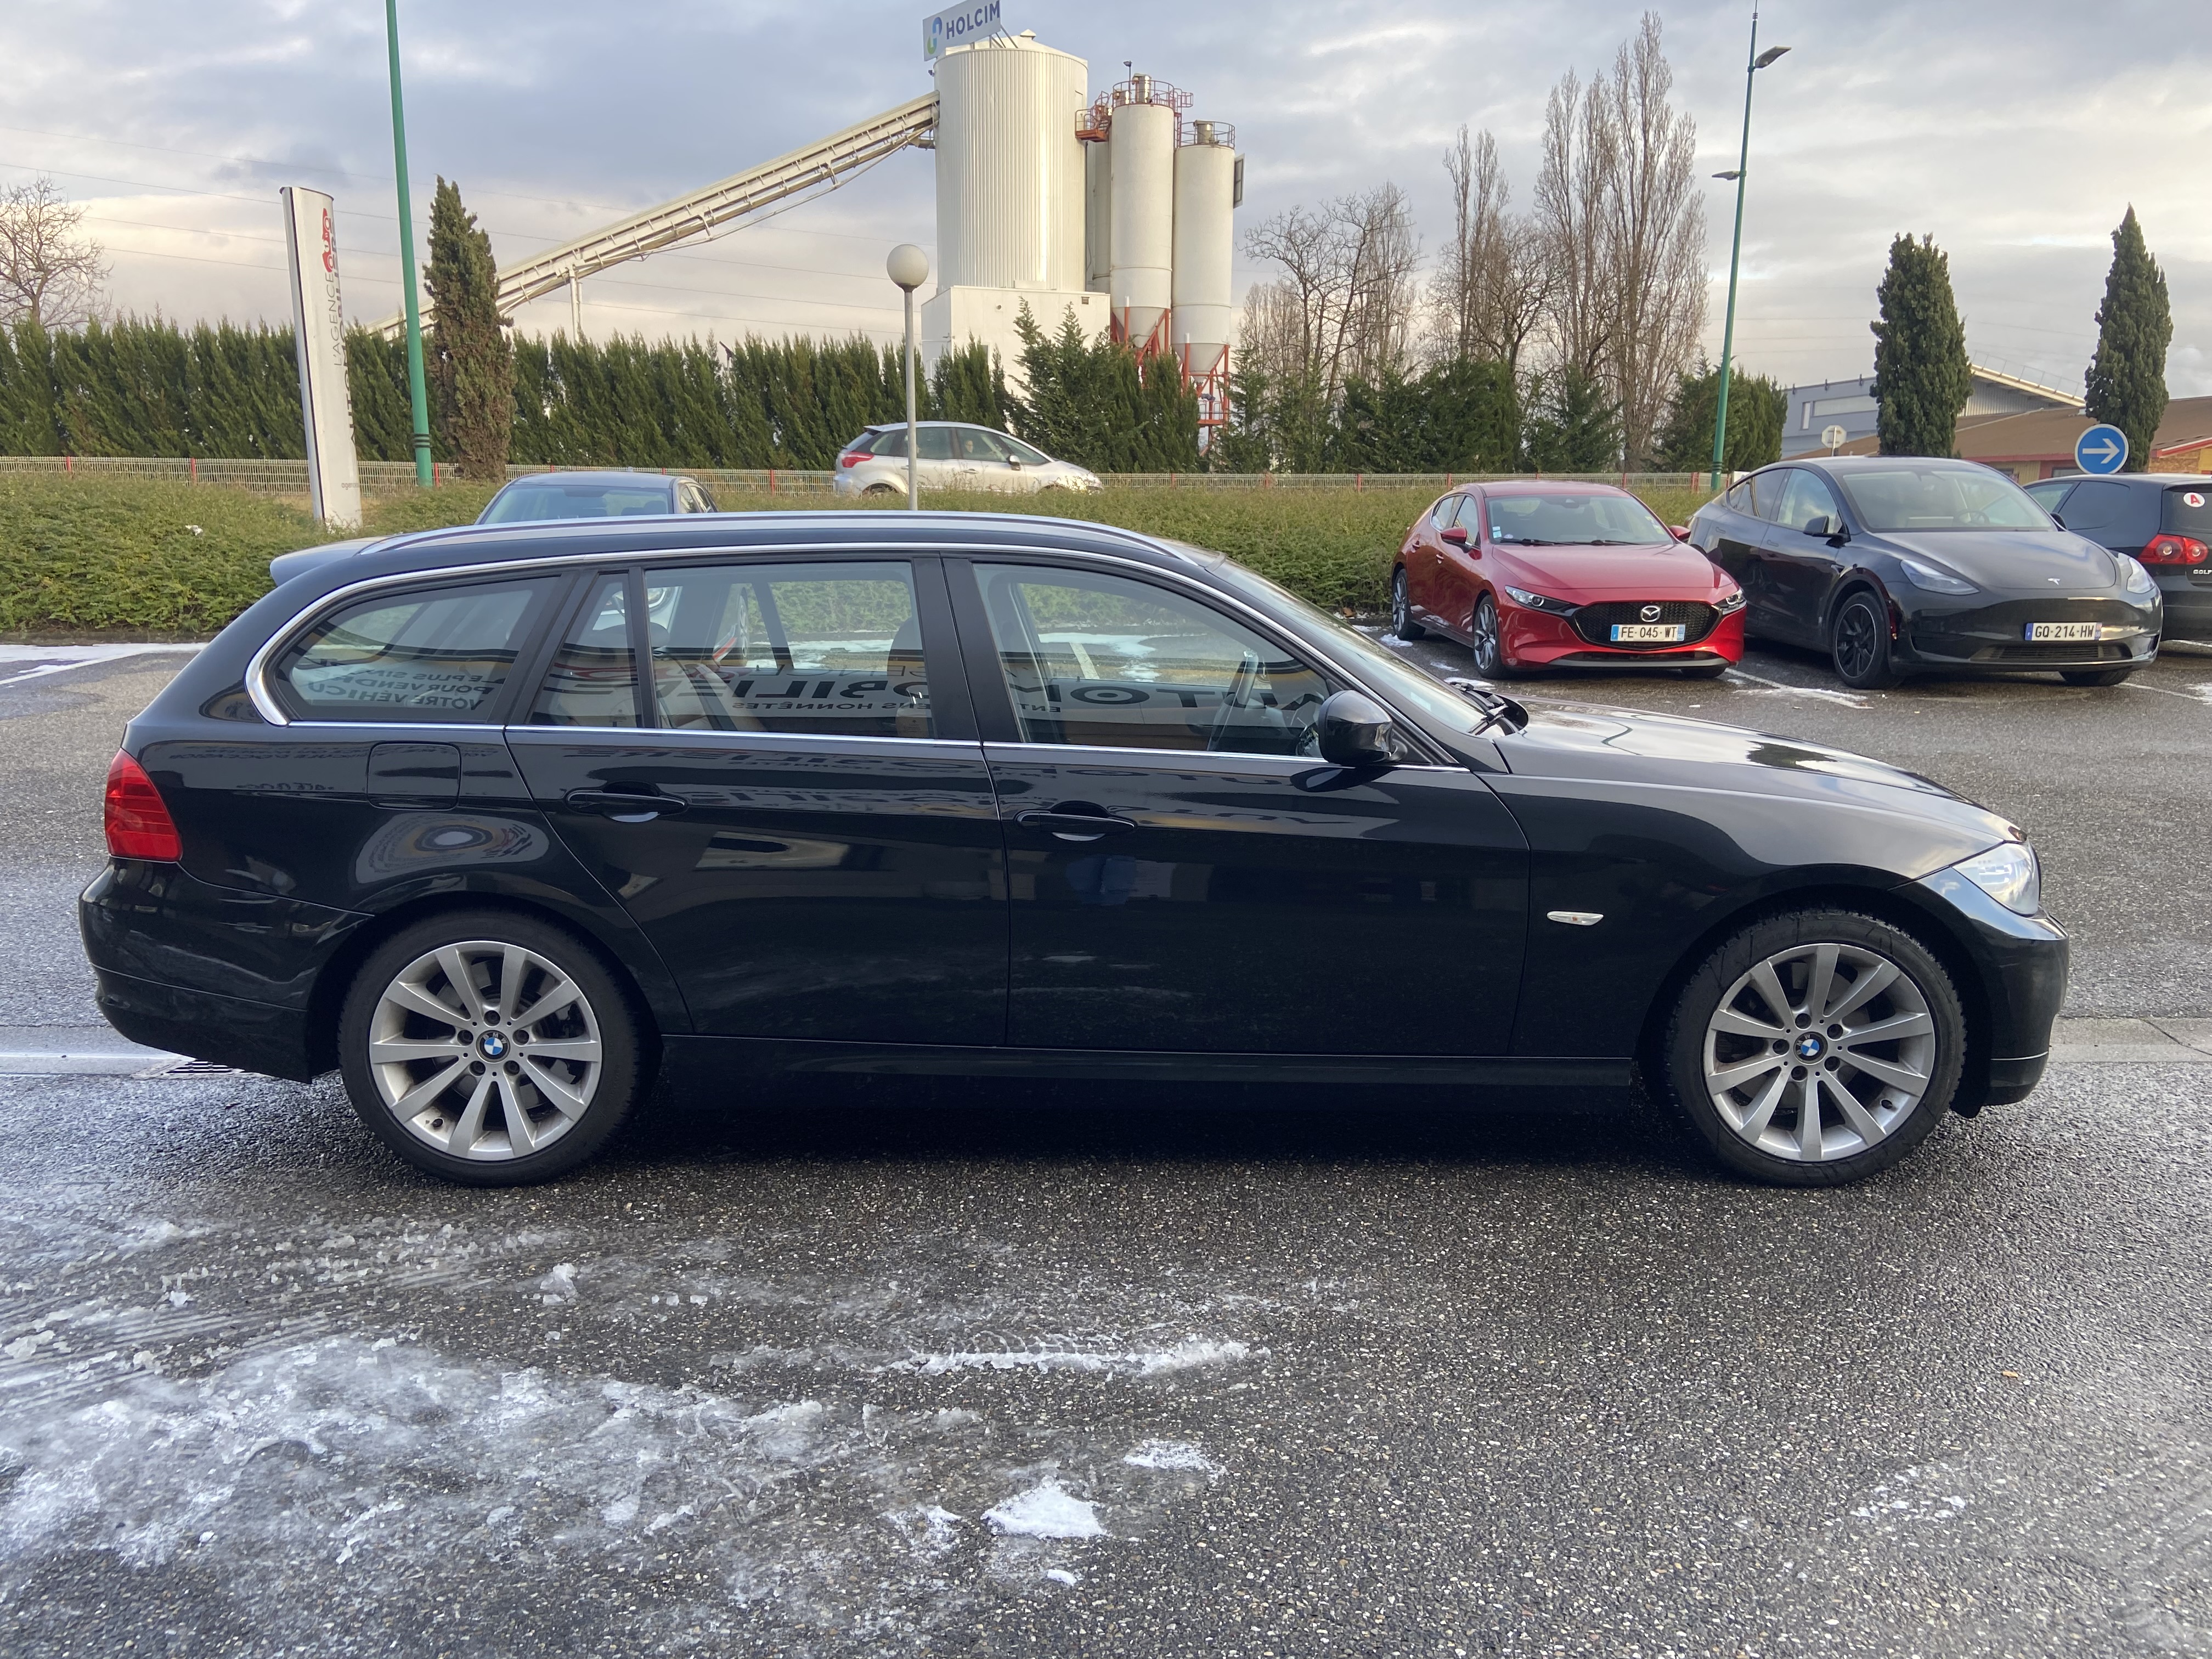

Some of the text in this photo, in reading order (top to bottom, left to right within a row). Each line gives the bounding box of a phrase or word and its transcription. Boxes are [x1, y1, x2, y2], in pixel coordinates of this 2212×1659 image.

[946, 1, 1000, 40] HOLCIM
[325, 272, 342, 366] L'AGENCE
[2190, 494, 2200, 504] A
[1621, 627, 1677, 638] FE-045-WT
[2035, 625, 2094, 637] GQ-214-HW
[483, 1031, 507, 1044] BMW
[1796, 1034, 1810, 1055] BMW
